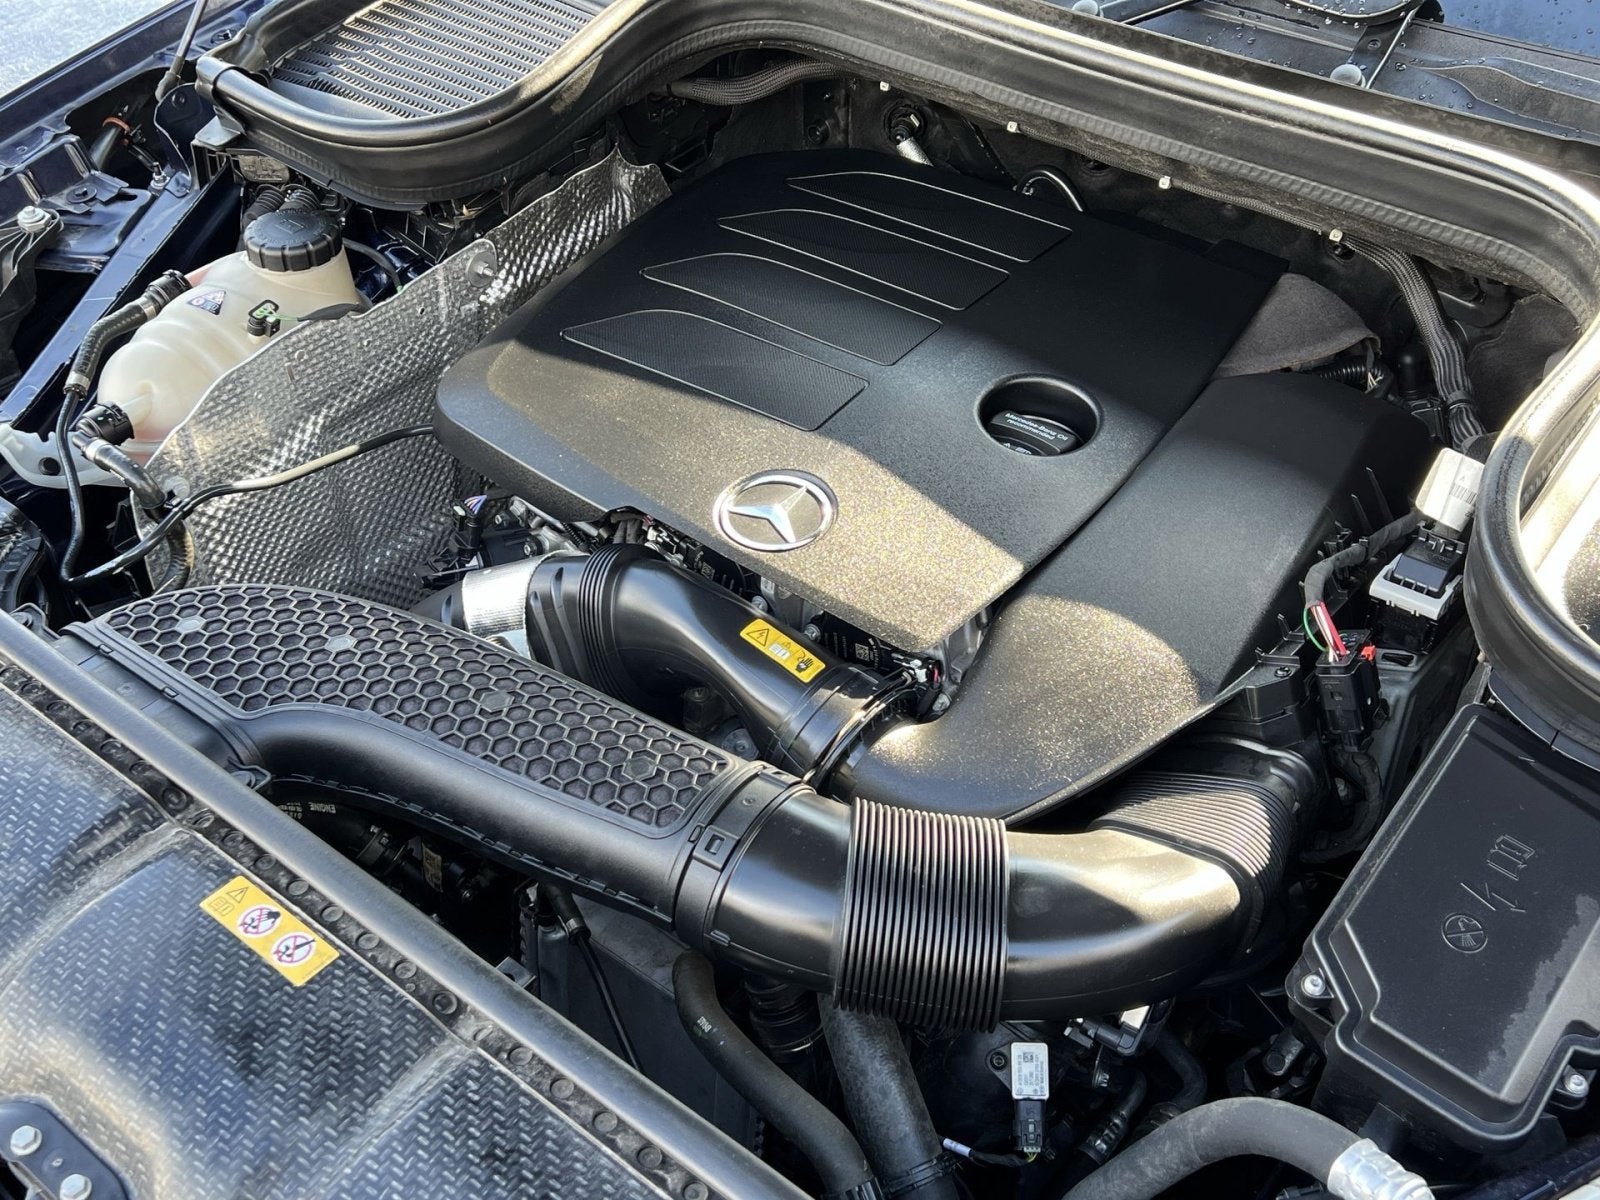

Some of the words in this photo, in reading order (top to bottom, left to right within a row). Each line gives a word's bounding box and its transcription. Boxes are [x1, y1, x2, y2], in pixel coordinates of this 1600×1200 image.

[1005, 413, 1057, 436] Mercedes-Benz
[1057, 433, 1069, 441] Oil
[1007, 419, 1056, 440] recommended
[309, 802, 336, 814] ENGINE
